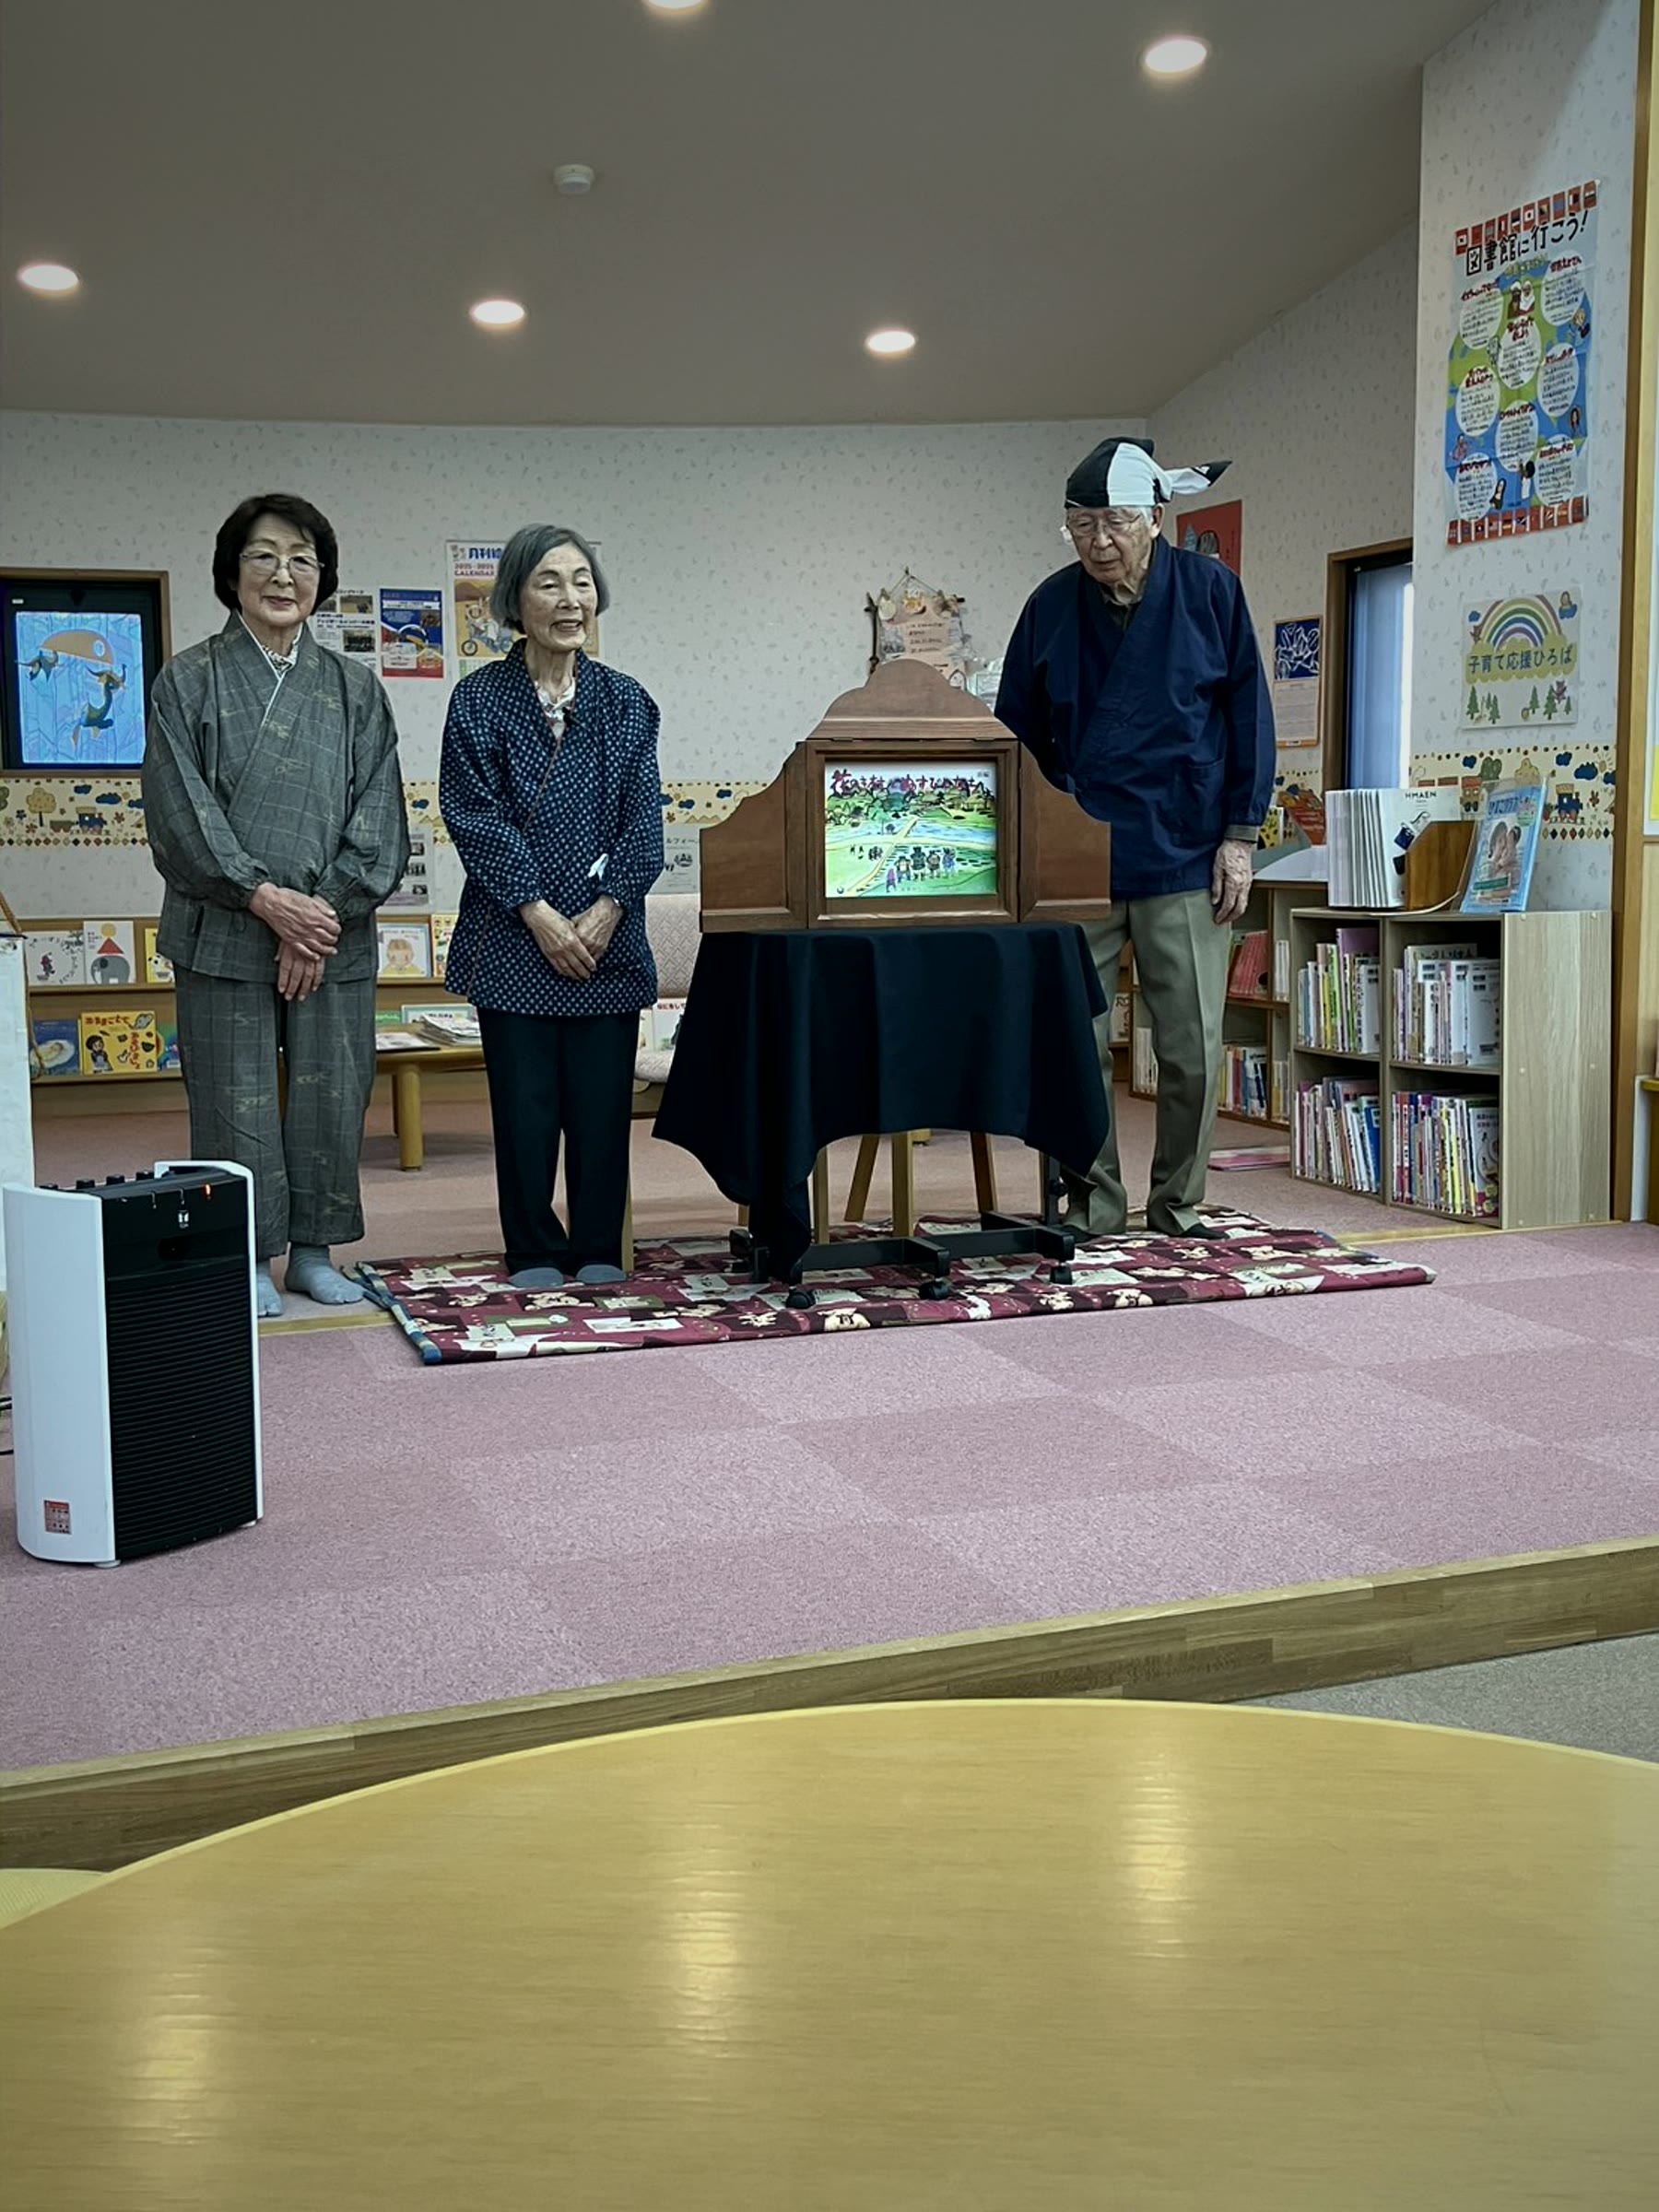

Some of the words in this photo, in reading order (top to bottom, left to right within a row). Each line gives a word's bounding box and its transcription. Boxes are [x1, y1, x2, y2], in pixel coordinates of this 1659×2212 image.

[1466, 210, 1588, 276] 図書館に行こう!
[1468, 645, 1573, 674] 子育て応援ひろば
